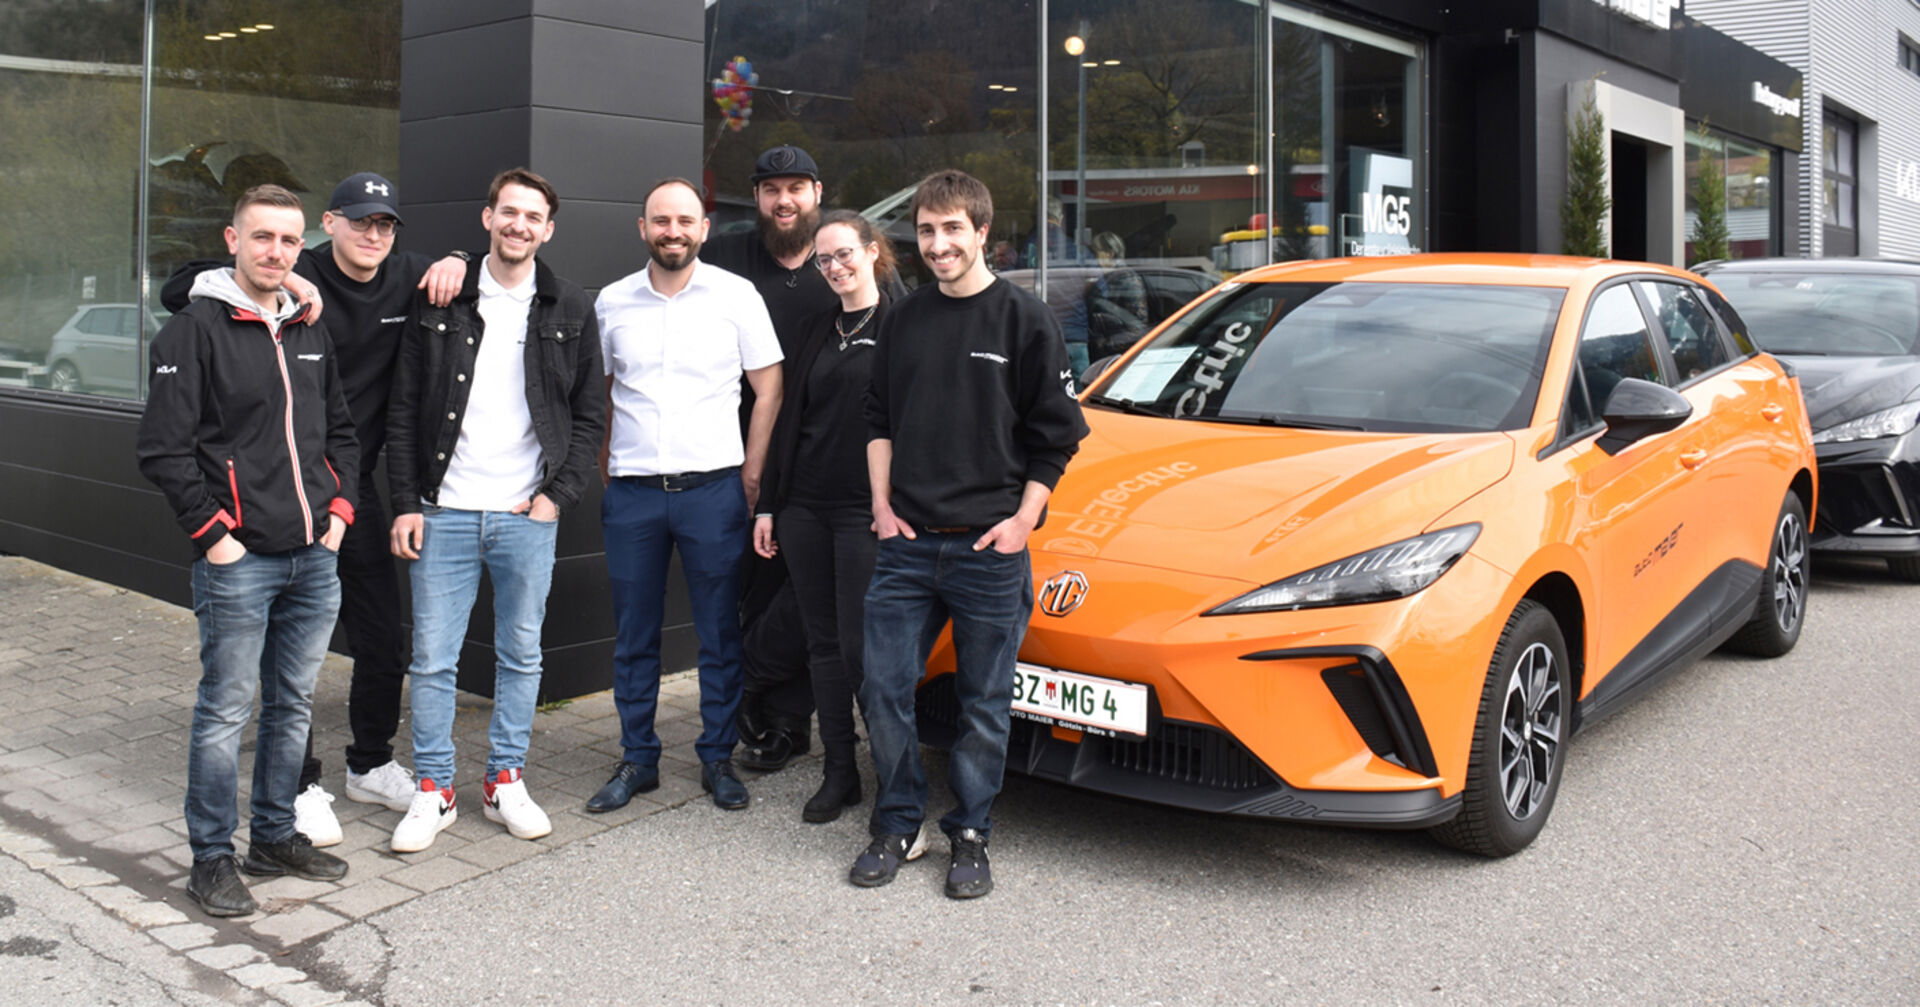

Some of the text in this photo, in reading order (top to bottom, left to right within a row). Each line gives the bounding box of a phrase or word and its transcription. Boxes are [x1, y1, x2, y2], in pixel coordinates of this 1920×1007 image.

[1363, 191, 1410, 236] MG5
[1045, 572, 1087, 612] MG
[1028, 713, 1054, 725] MAIER
[1061, 680, 1095, 716] MG
[1103, 689, 1118, 721] 4
